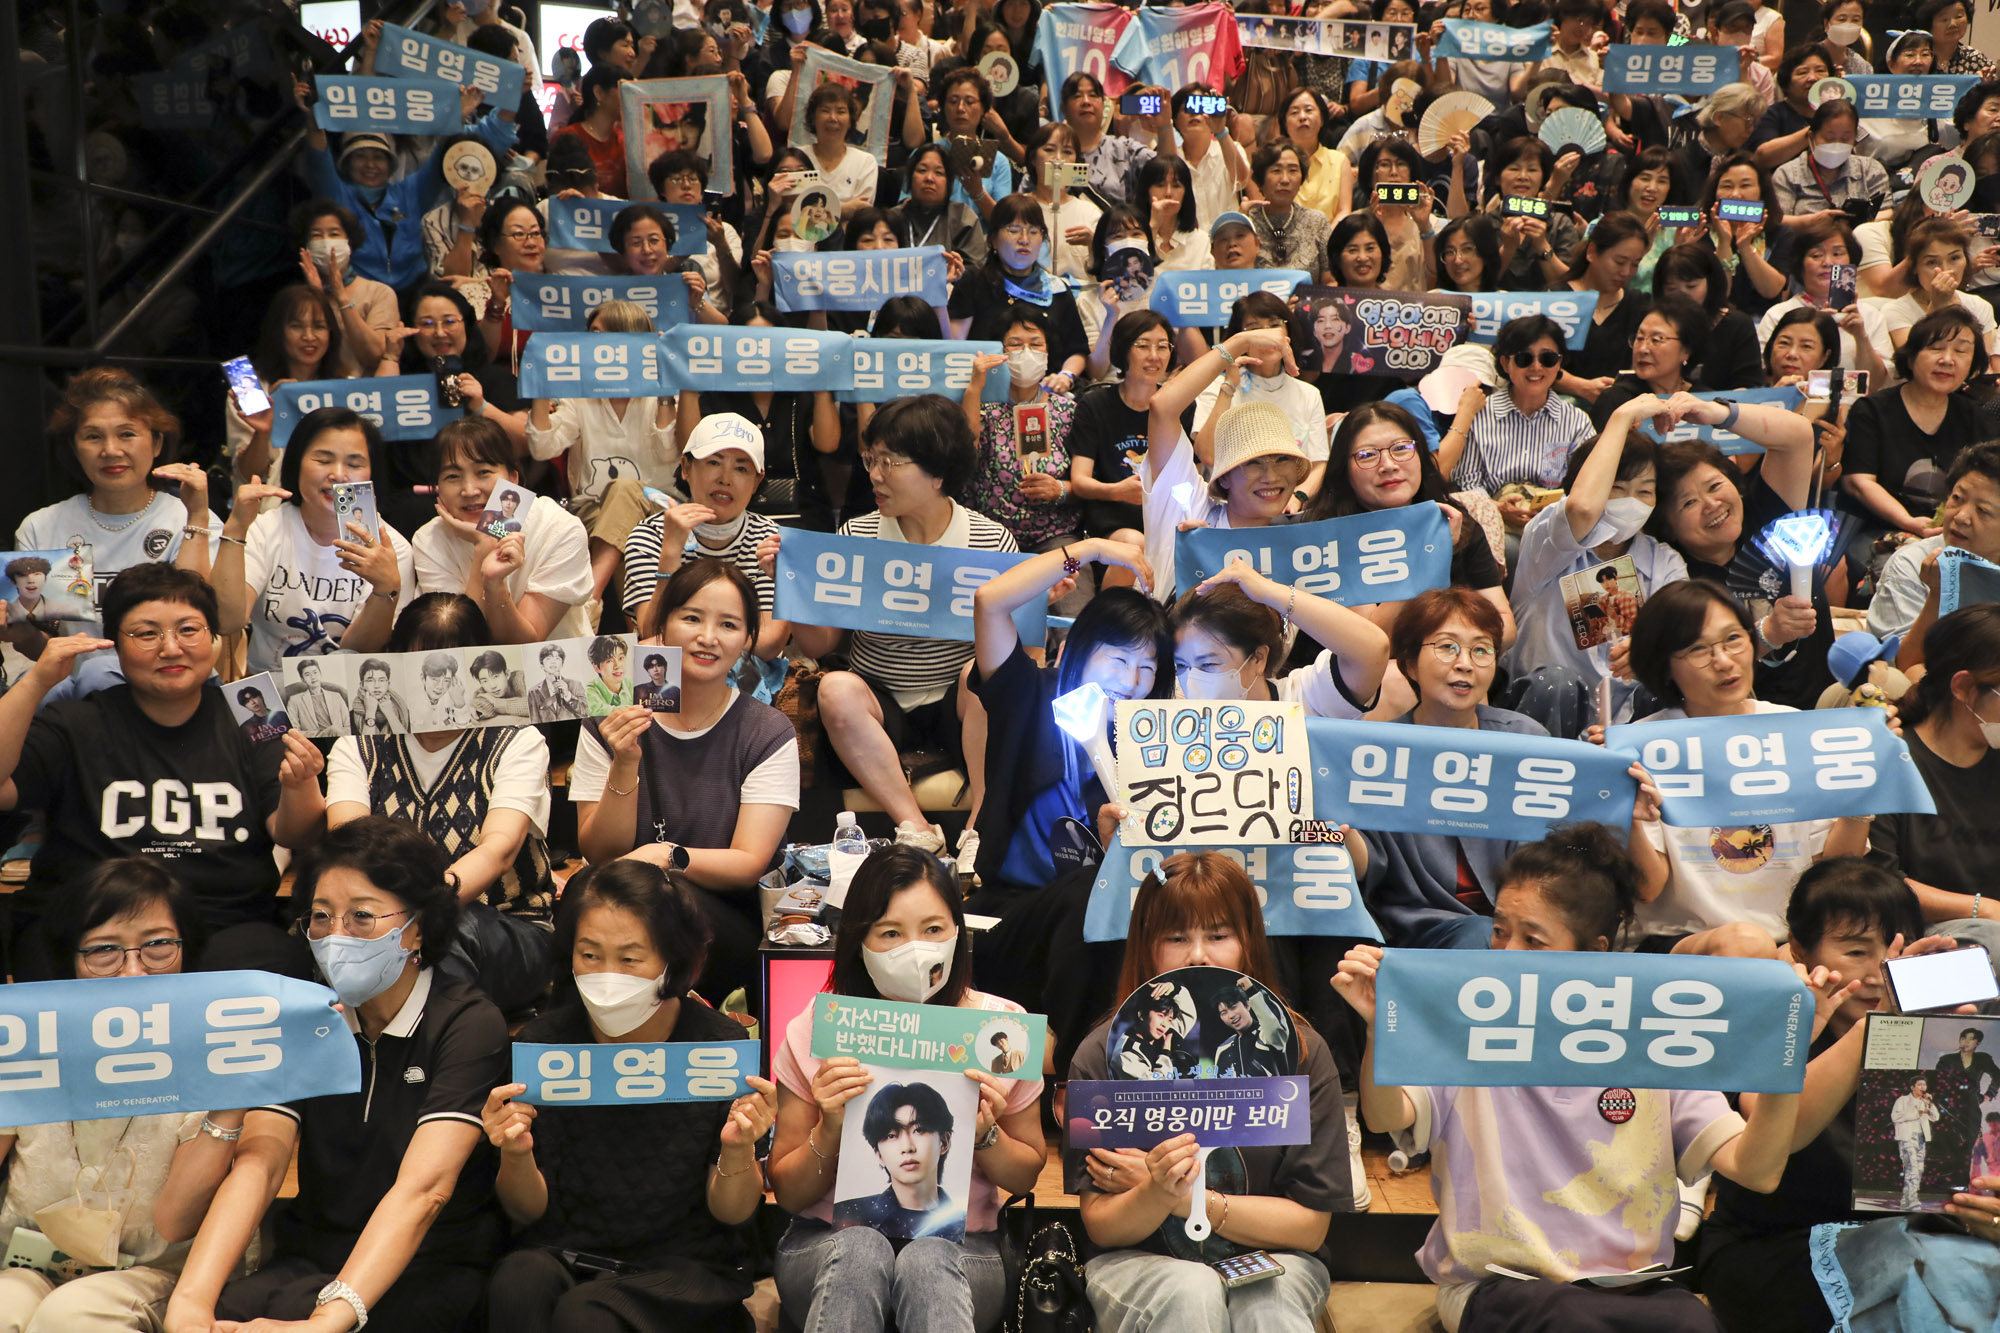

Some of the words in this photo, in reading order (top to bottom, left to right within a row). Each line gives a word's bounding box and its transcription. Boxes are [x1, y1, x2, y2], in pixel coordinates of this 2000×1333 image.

[1456, 27, 1536, 57] 임영웅
[401, 38, 501, 94] 임영웅
[1062, 46, 1107, 88] 10
[1161, 52, 1211, 96] 10
[1625, 55, 1717, 83] 임영웅
[326, 85, 434, 122] 임영웅
[1139, 97, 1161, 114] 임
[1864, 83, 1957, 111] 임영웅
[793, 255, 925, 297] 영웅시대
[687, 336, 821, 375] 임영웅
[853, 351, 974, 389] 임영웅
[1388, 349, 1429, 367] 이야
[1114, 439, 1140, 451] TASTY
[814, 552, 1001, 617] 임영웅
[878, 618, 894, 626] HERO
[894, 620, 930, 629] GENERATION
[1575, 620, 1590, 647] HERO
[639, 698, 675, 708] HERO
[250, 725, 288, 742] HERO
[257, 723, 275, 733] IM
[1642, 727, 1878, 798] 임영웅
[1348, 744, 1576, 819] 임영웅
[100, 778, 249, 843] CGP.
[1427, 818, 1446, 826] HERO
[1447, 819, 1489, 830] GENERATION
[1290, 829, 1344, 844] HERO
[1305, 820, 1328, 832] IM
[836, 1006, 921, 1035] 자신감에
[1387, 1000, 1397, 1033] HERO
[1457, 973, 1729, 1067] 임영웅
[1783, 993, 1802, 1067] GENERATION
[0, 996, 283, 1092] 임영웅
[836, 1031, 946, 1062] 반했다니까!
[538, 1047, 740, 1101] 임영웅
[96, 1100, 121, 1108] HERO
[123, 1094, 180, 1106] GENERATION
[1237, 1090, 1261, 1098] YOU
[1603, 1088, 1631, 1100] KIDSUPER
[1091, 1107, 1136, 1133] 오직
[1144, 1105, 1237, 1132] 영웅이만
[1244, 1103, 1290, 1129] 보여
